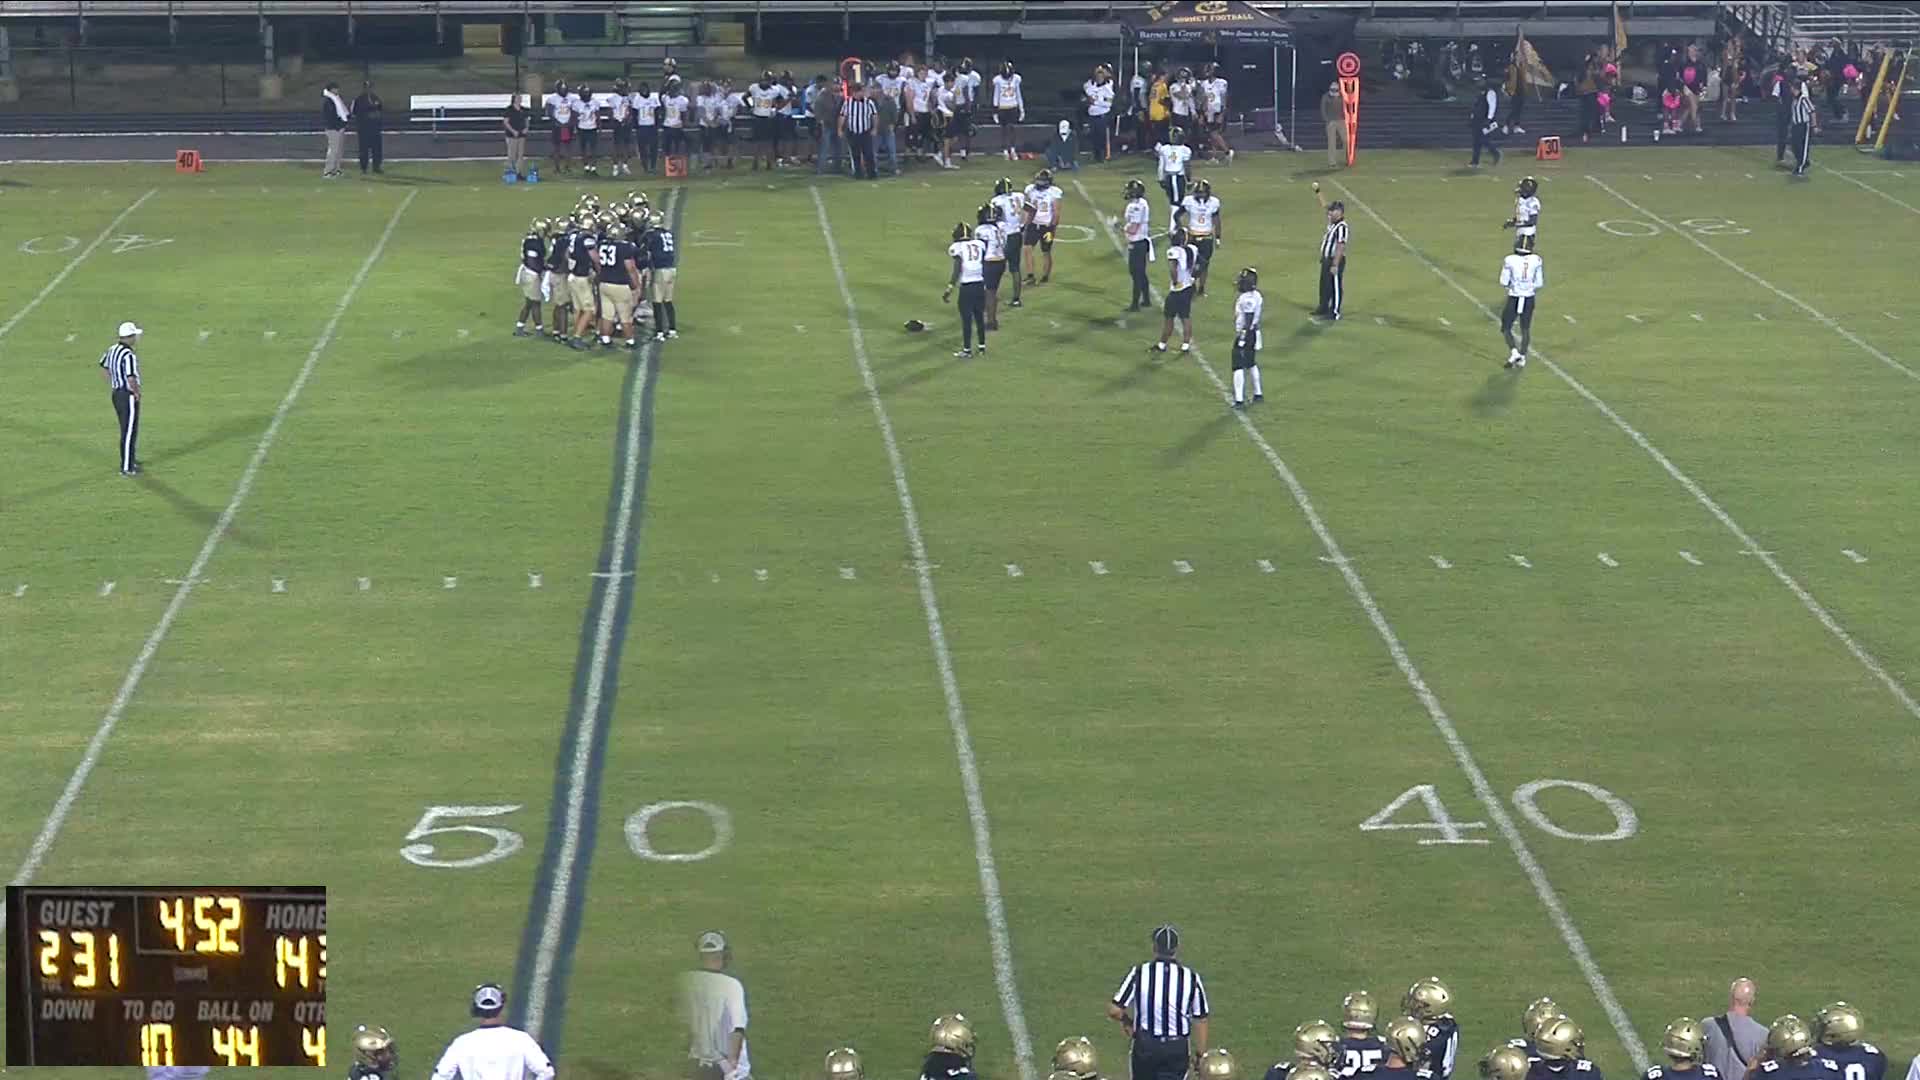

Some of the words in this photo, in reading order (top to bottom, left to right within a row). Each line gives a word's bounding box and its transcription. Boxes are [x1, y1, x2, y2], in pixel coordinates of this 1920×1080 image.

[1209, 13, 1255, 22] FOOTBALL
[851, 63, 862, 83] 1
[1544, 139, 1559, 155] 30
[179, 151, 194, 169] 40
[599, 244, 617, 267] 53
